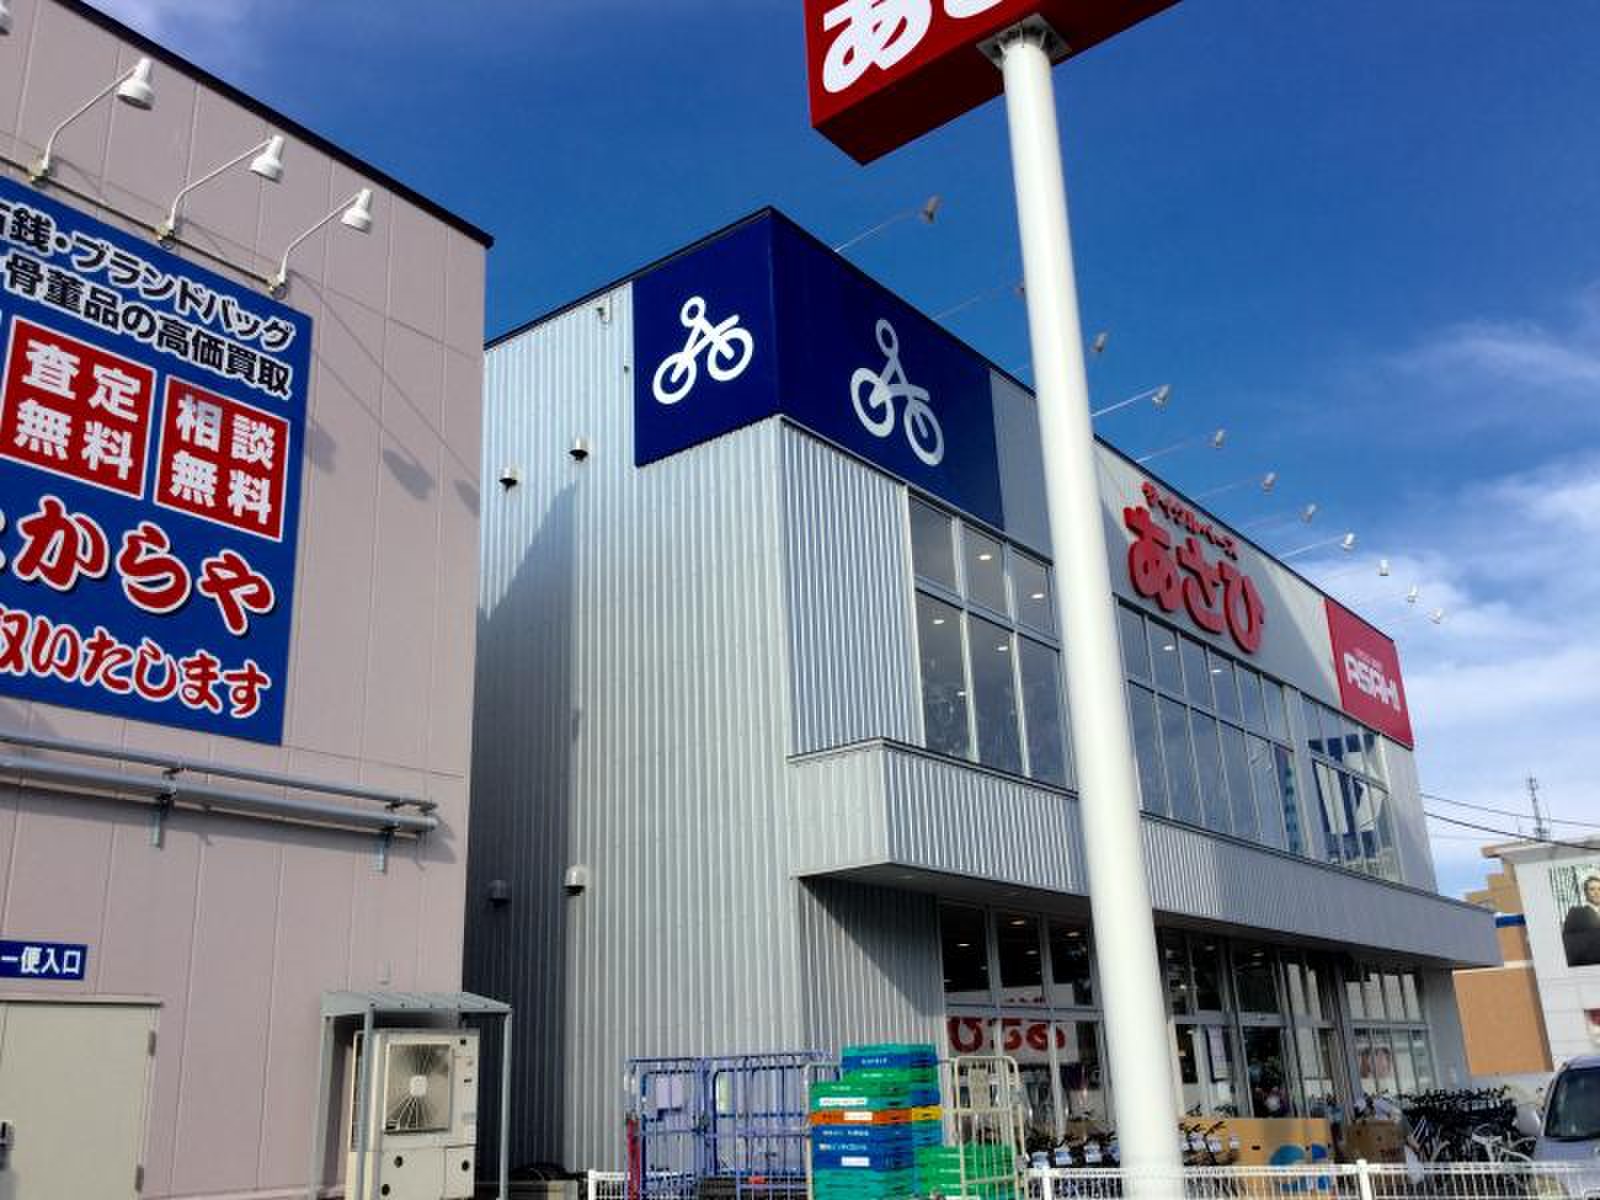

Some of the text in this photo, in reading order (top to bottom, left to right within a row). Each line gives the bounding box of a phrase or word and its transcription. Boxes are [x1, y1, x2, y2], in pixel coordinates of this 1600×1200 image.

[0, 200, 294, 349] 銭・ブランドバッグ
[5, 252, 292, 398] 骨董品の高価買取
[21, 339, 141, 423] 査定
[176, 394, 275, 471] 相談
[13, 398, 133, 480] 無料
[169, 450, 272, 525] 無料
[0, 495, 275, 635] からや
[1123, 506, 1264, 655] あさひ
